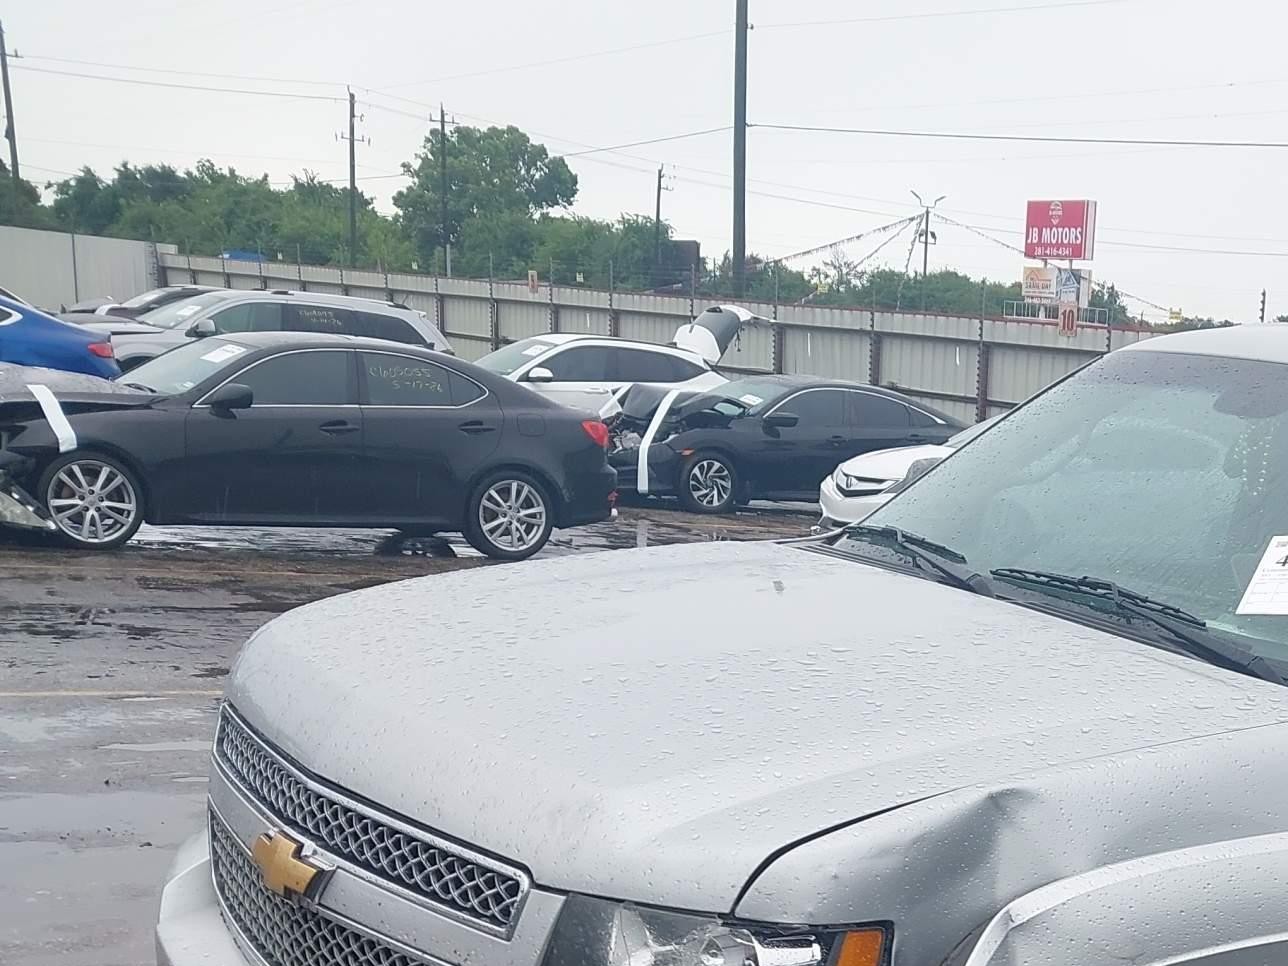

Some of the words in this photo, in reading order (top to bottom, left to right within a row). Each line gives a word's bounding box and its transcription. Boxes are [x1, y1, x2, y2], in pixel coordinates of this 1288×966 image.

[1027, 227, 1038, 244] JB
[1041, 227, 1082, 245] MOTORS
[1061, 309, 1075, 331] 10
